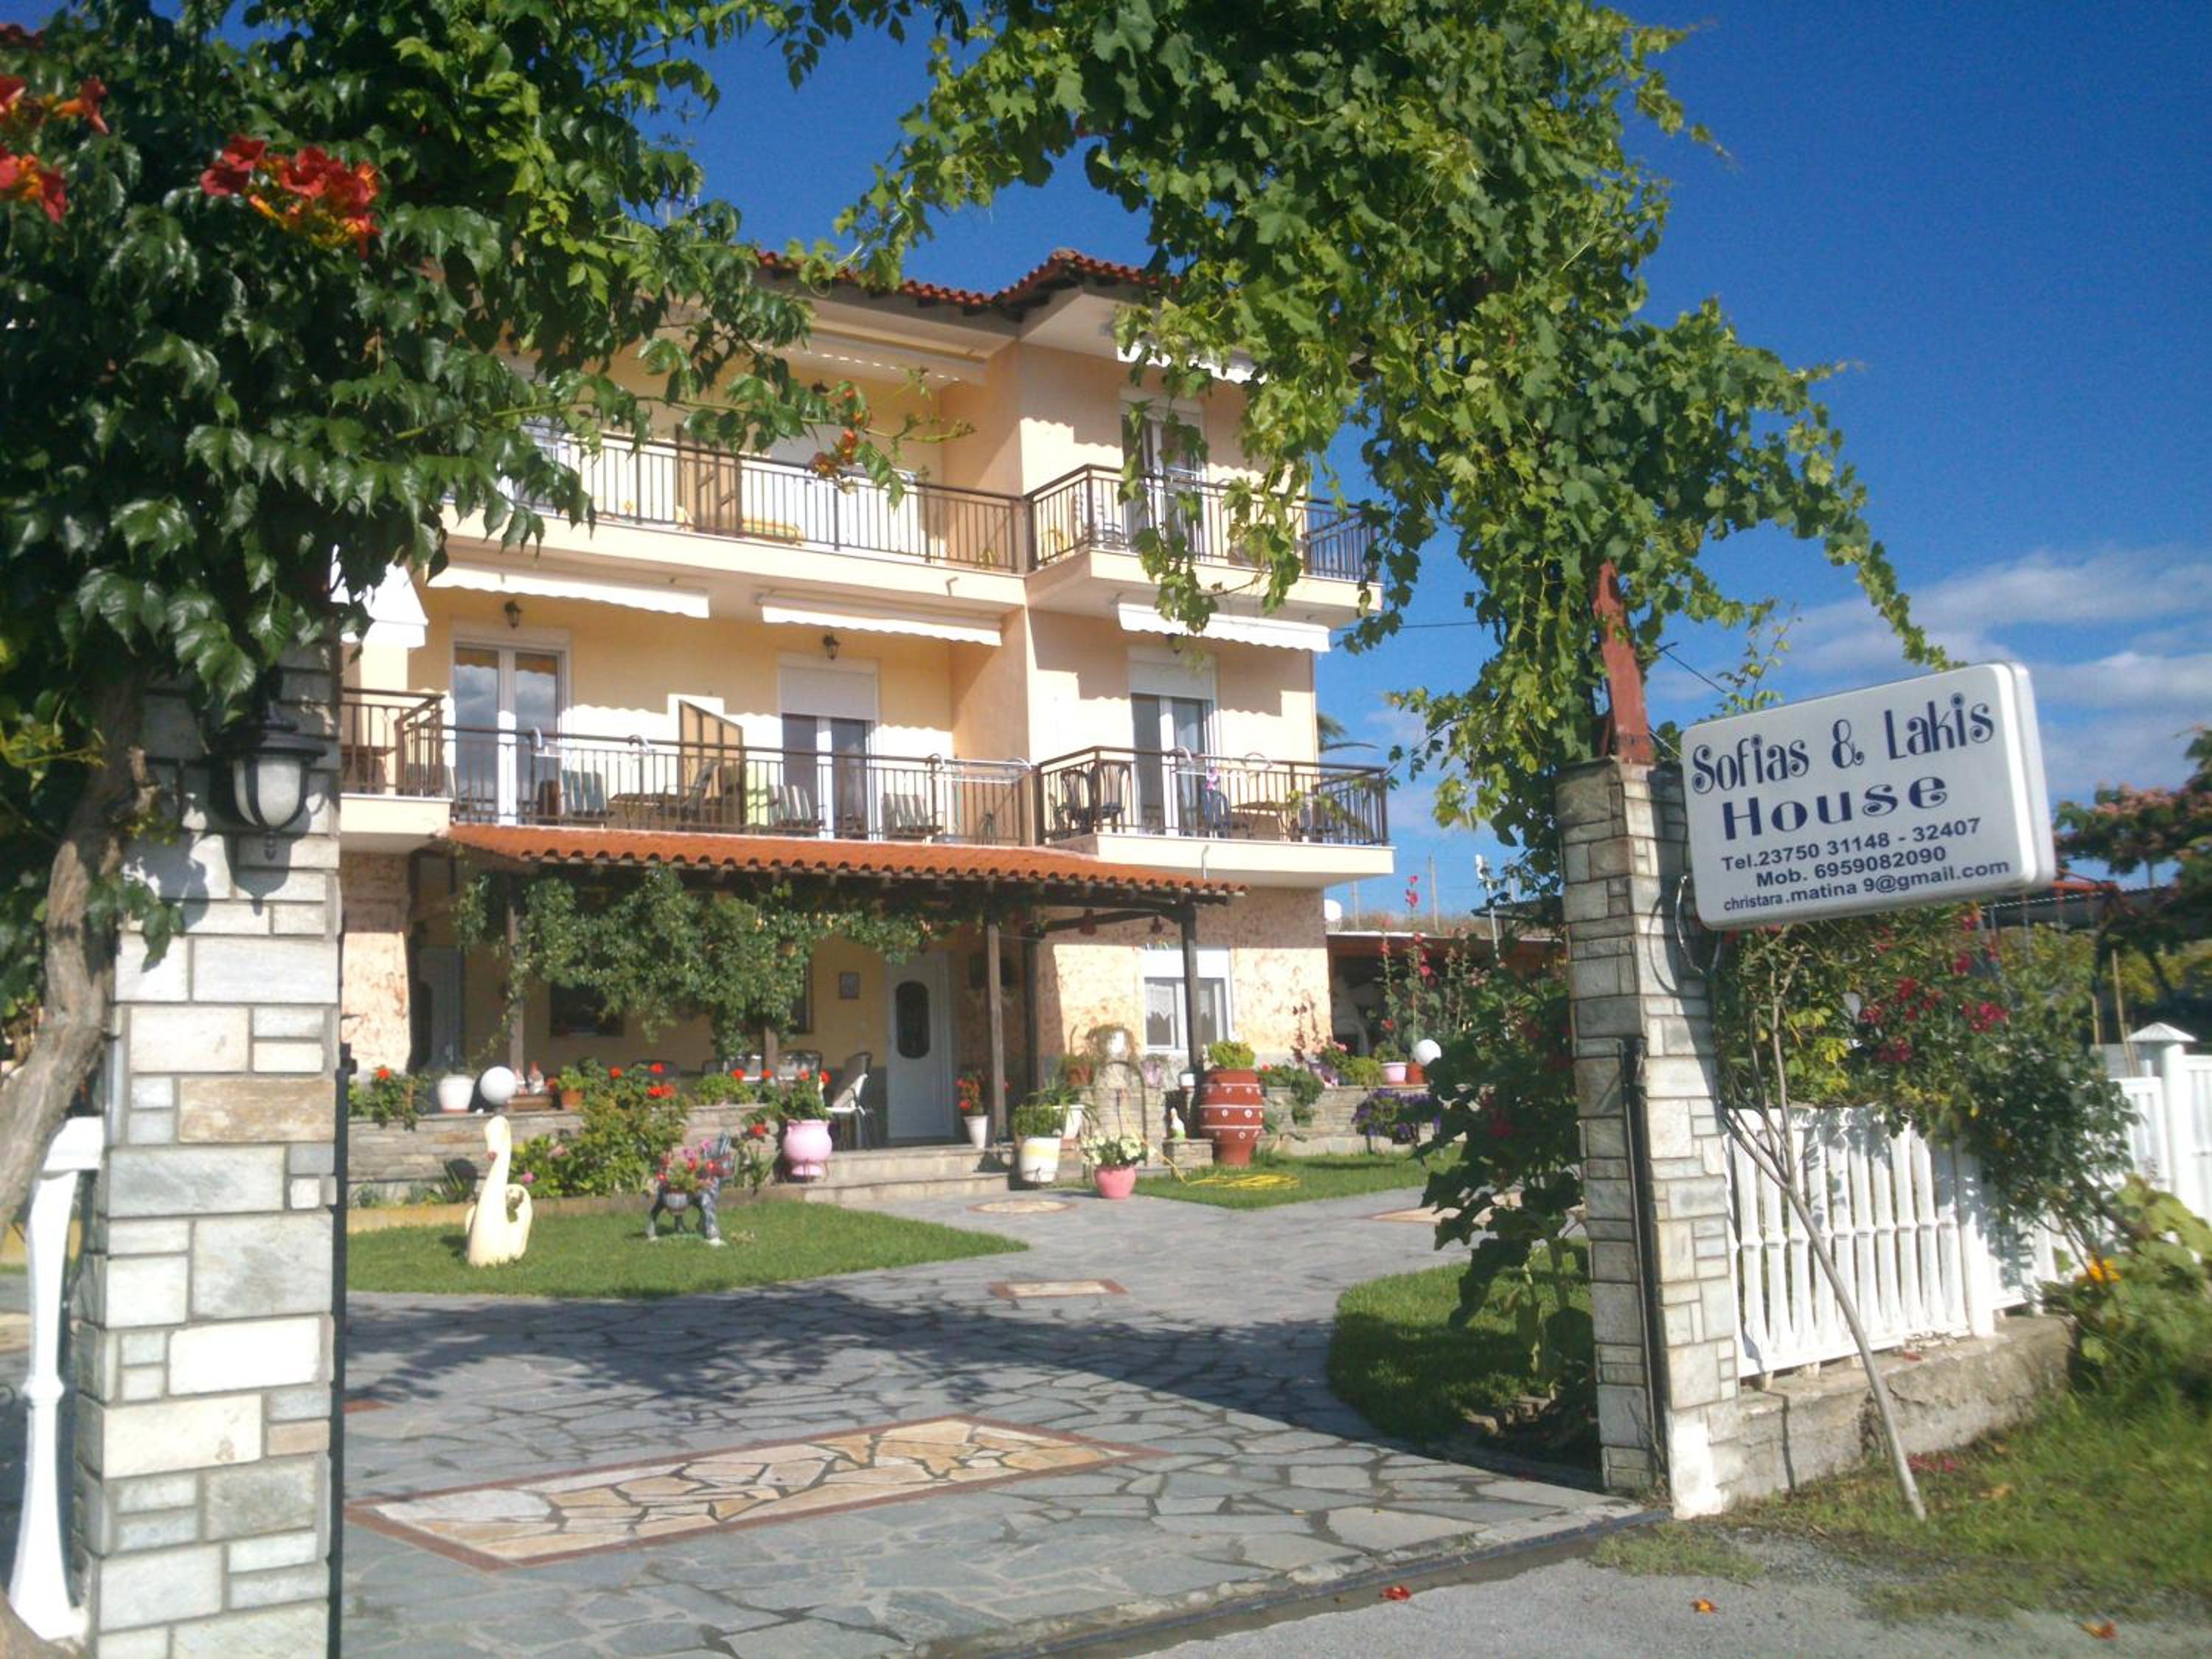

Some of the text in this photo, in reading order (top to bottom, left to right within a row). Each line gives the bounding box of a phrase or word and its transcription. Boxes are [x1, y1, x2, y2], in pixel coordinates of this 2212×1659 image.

[1692, 692, 1994, 794] Sofias & Lakis
[1722, 776, 1948, 840] House
[1722, 843, 1820, 872] Tel.23750
[1826, 833, 1890, 856] 31148
[1912, 817, 1981, 842] 32407
[1756, 846, 1947, 888] Mob. 6959082090
[1863, 860, 2011, 894] 9@gmail.com
